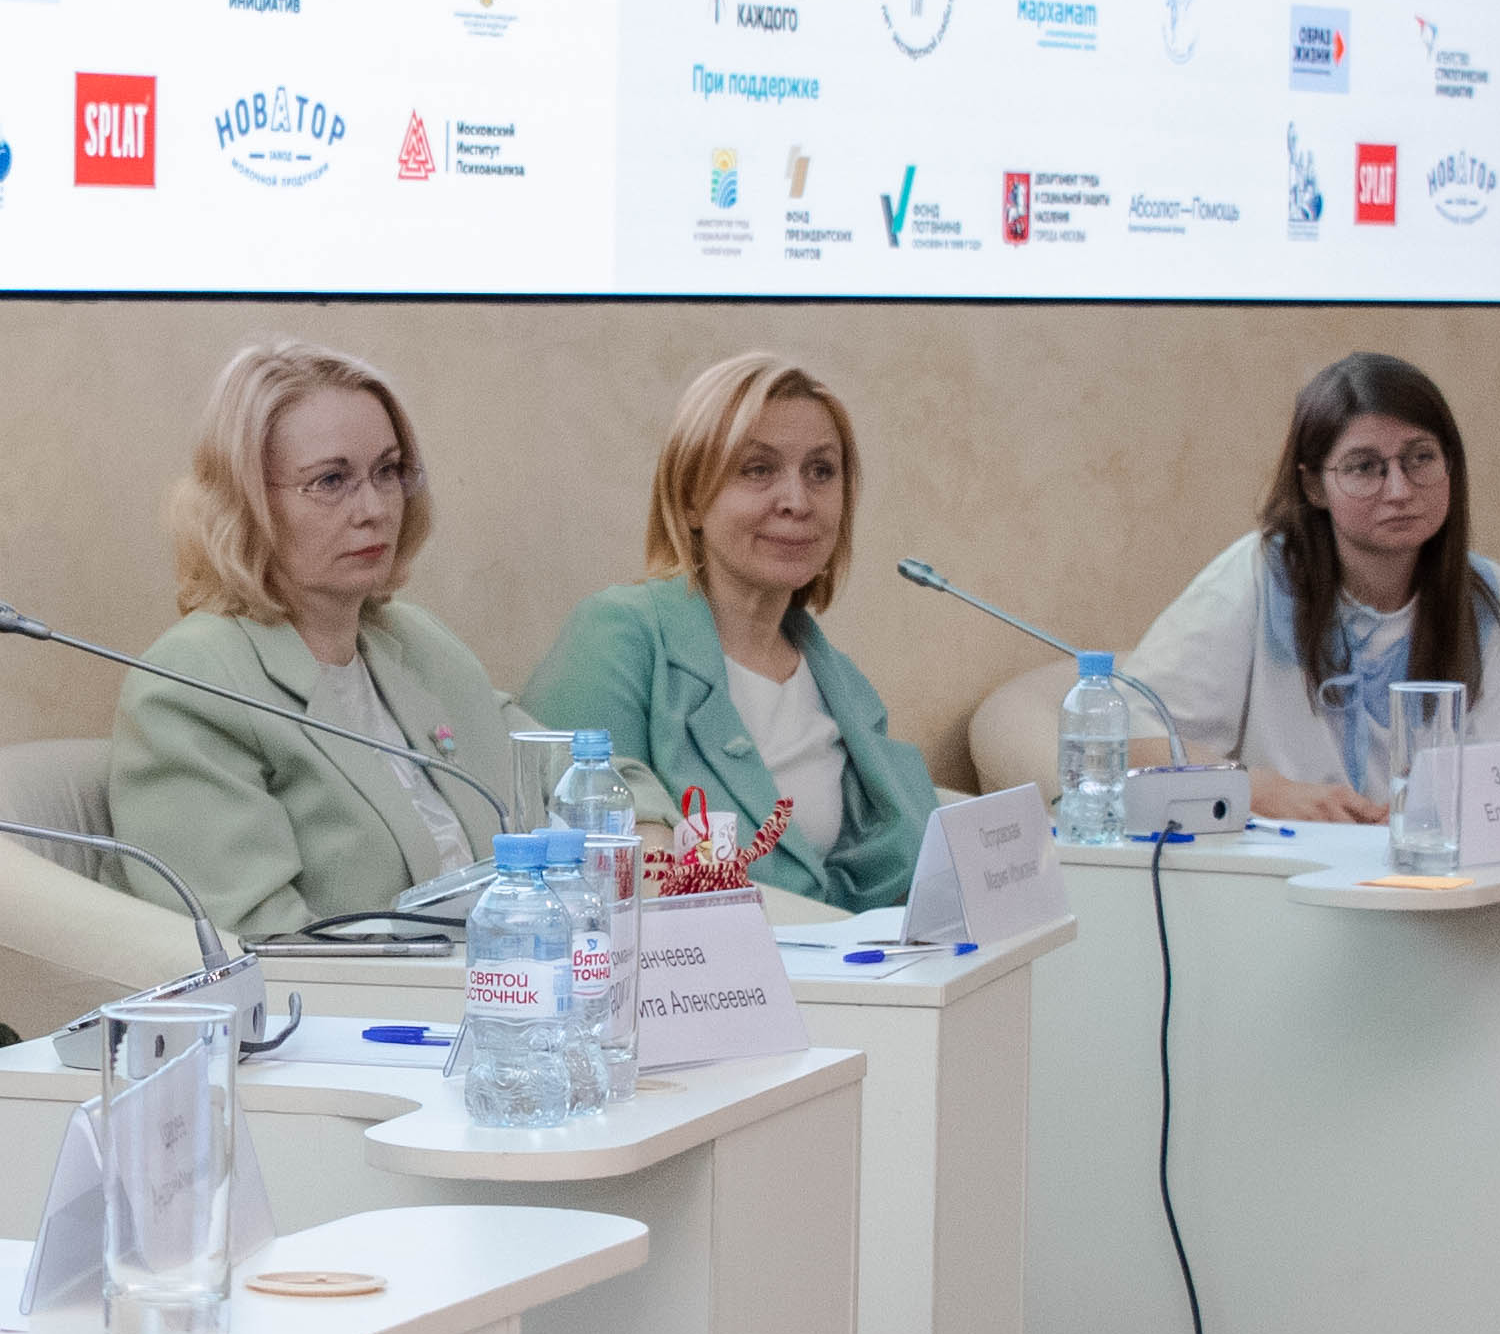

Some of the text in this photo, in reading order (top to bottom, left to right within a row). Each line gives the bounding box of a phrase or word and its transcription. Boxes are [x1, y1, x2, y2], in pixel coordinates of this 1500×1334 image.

[737, 4, 798, 33] КАЖДОГО
[693, 64, 819, 102] При поддержке
[85, 101, 147, 159] SPLAT
[215, 85, 345, 150] НОВАТОР
[672, 986, 766, 1013] Алексеевна
